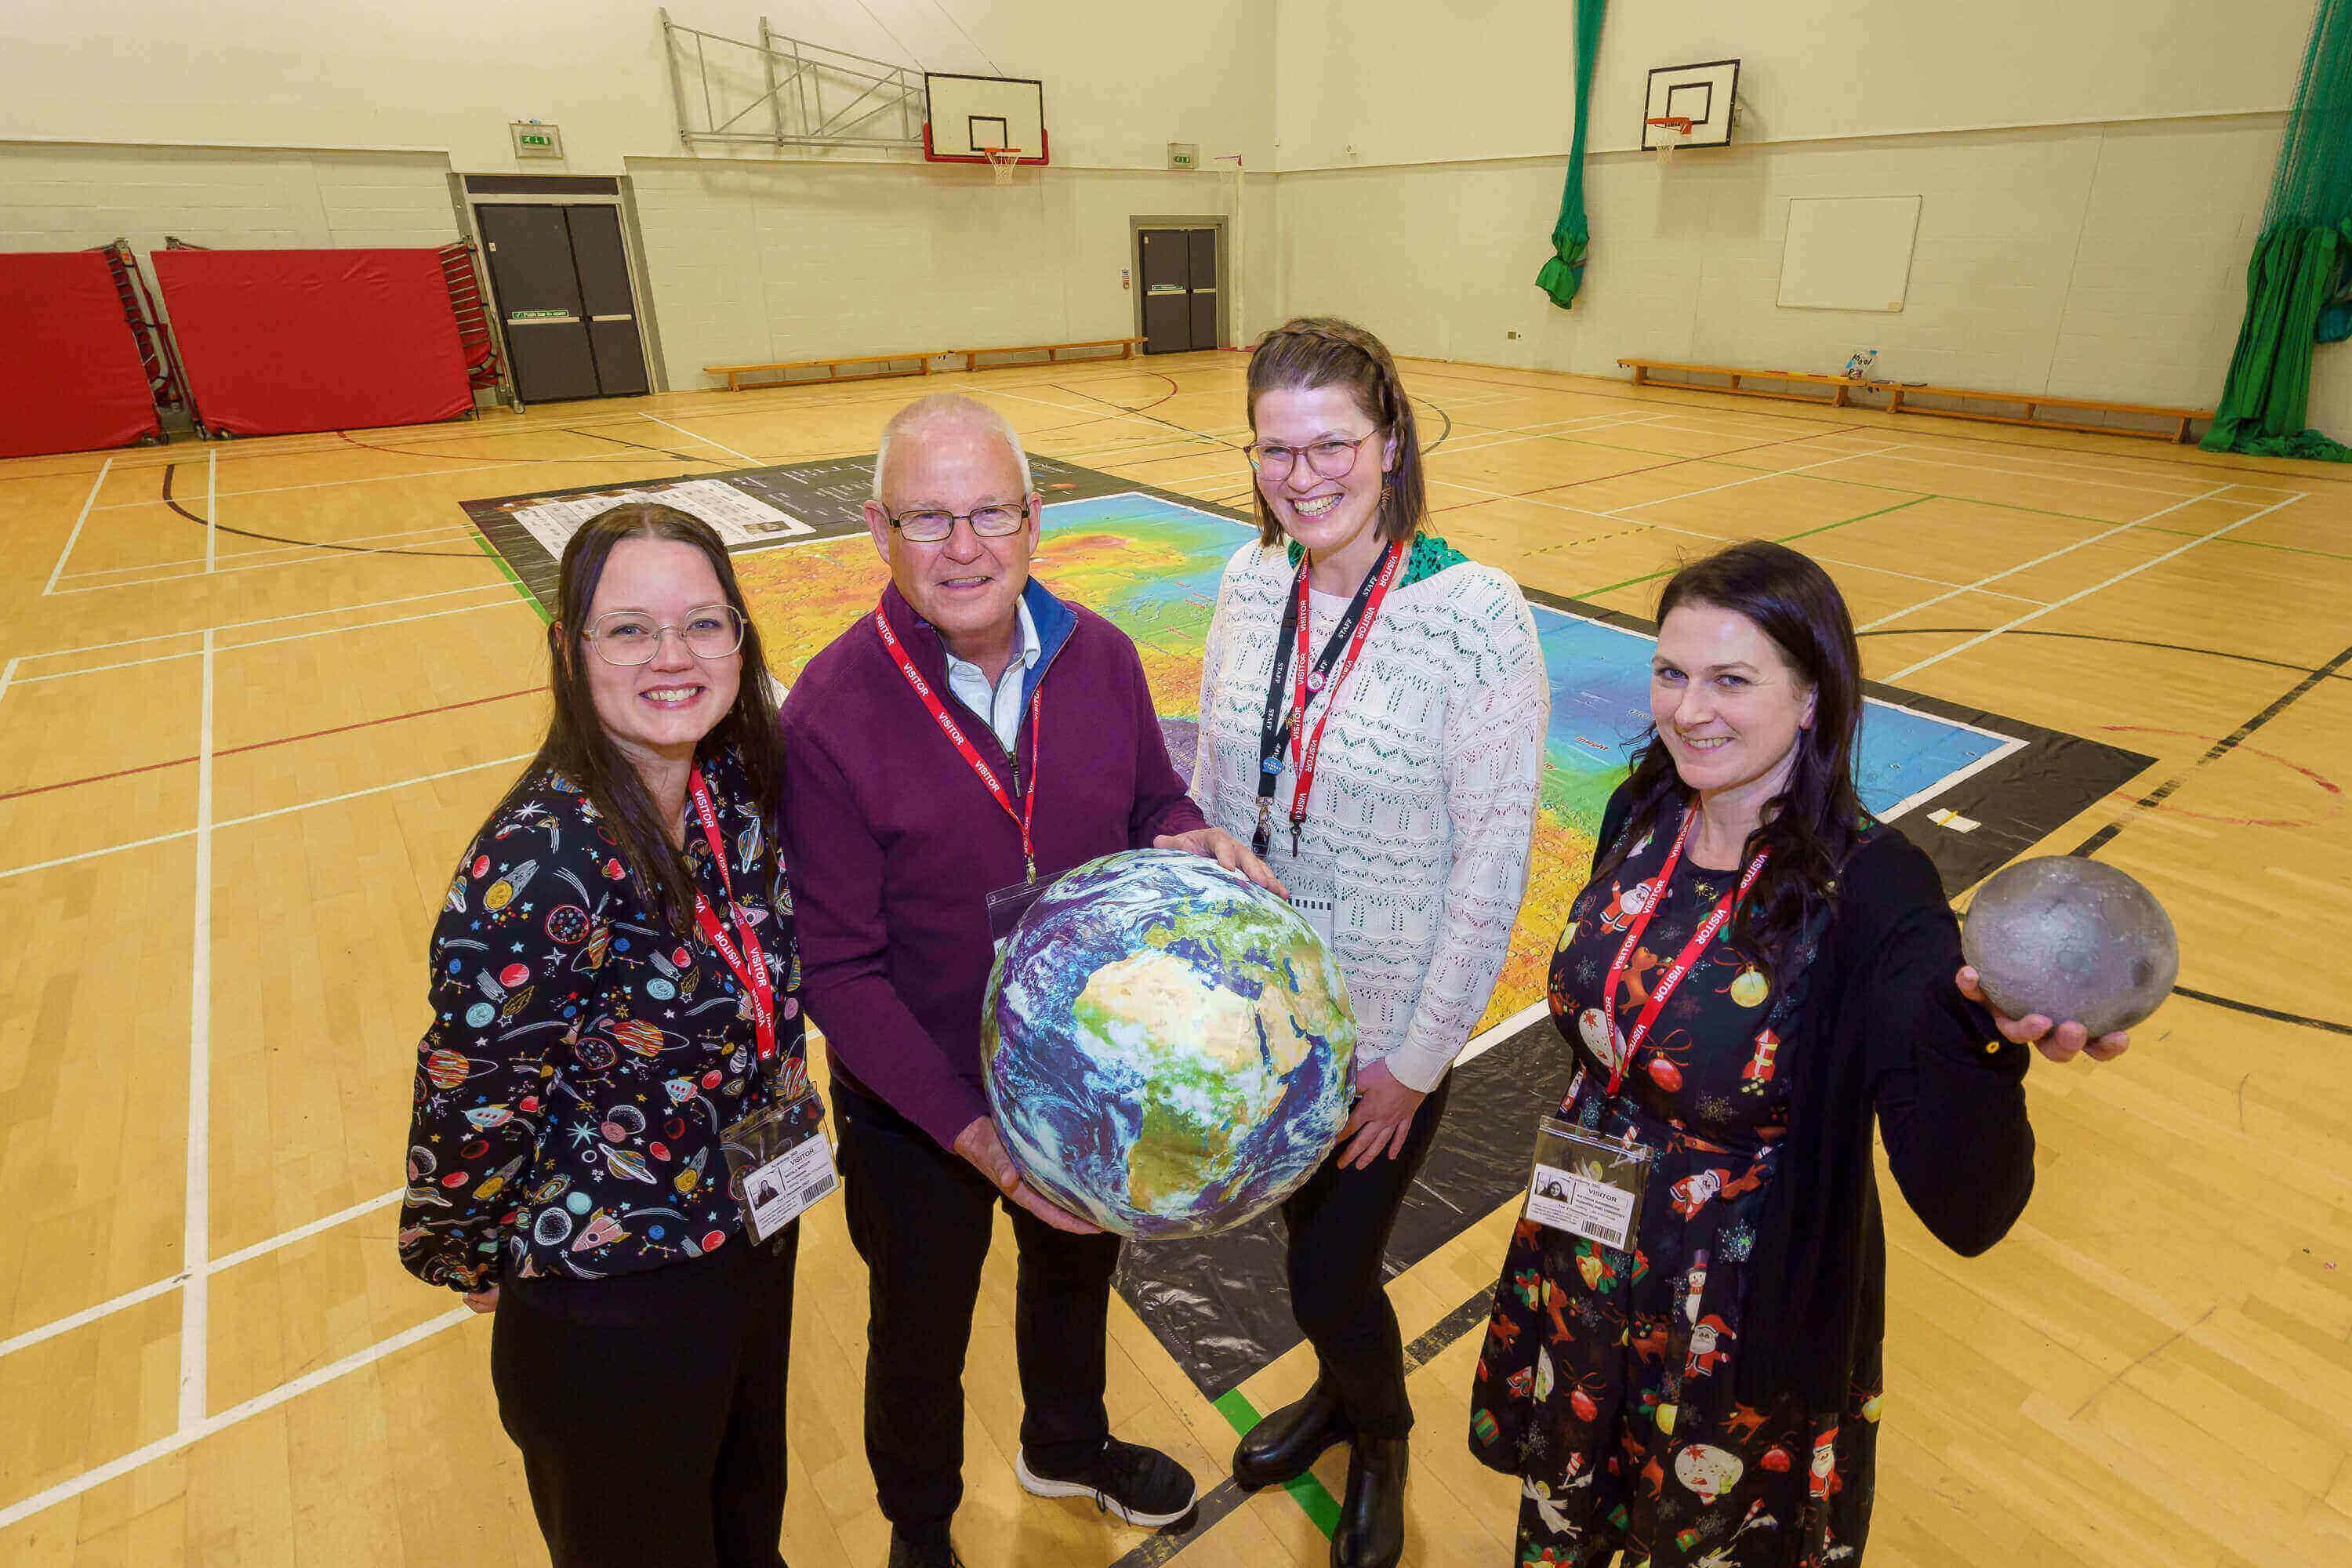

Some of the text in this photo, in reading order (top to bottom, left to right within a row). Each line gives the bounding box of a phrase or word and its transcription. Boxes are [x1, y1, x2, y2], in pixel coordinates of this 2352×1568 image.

[1363, 575, 1377, 597] STAFF
[1378, 555, 1398, 587] VISITOR
[876, 613, 895, 646] VISITOR
[1357, 607, 1376, 639] VISITOR
[902, 662, 930, 696] VISITOR
[938, 711, 964, 746] VISITOR
[1293, 706, 1302, 740] VISITOR
[1305, 739, 1318, 773] VISITOR
[975, 760, 1000, 793] VISITOR
[694, 789, 714, 829] VISITOR
[1740, 853, 1768, 891] VISITOR
[1642, 879, 1666, 915] VISITOR
[1694, 908, 1728, 946] VISITOR
[714, 931, 741, 969] VISITOR
[1613, 934, 1637, 971] VISITOR
[750, 947, 768, 989] VISITOR
[1653, 964, 1685, 1003] VISITOR
[1603, 995, 1615, 1037] VISITOR
[789, 1147, 815, 1167] VISITOR
[1588, 1189, 1618, 1203] VISITOR
